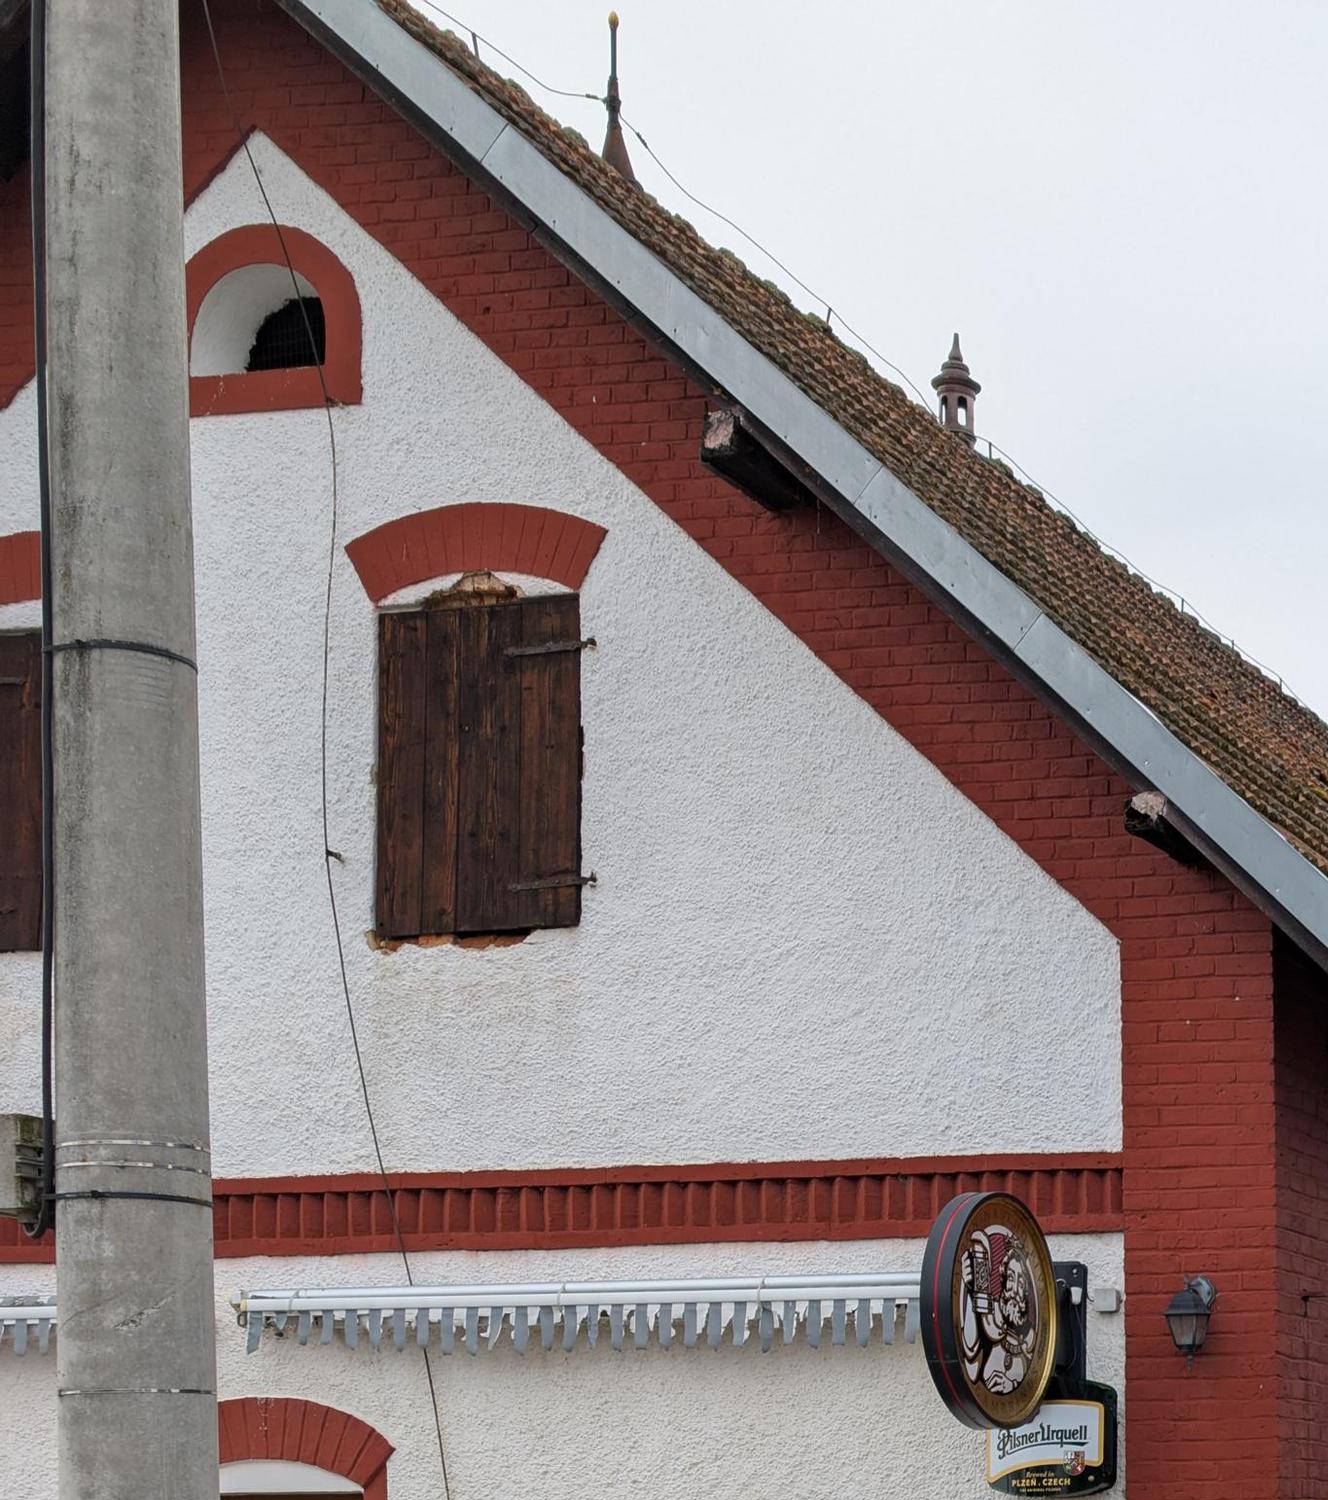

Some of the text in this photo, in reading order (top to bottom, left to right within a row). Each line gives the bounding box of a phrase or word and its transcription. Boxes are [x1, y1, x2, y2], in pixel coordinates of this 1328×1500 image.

[997, 1423, 1087, 1459] Pilsner Urquell
[1042, 1478, 1071, 1486] CZECH
